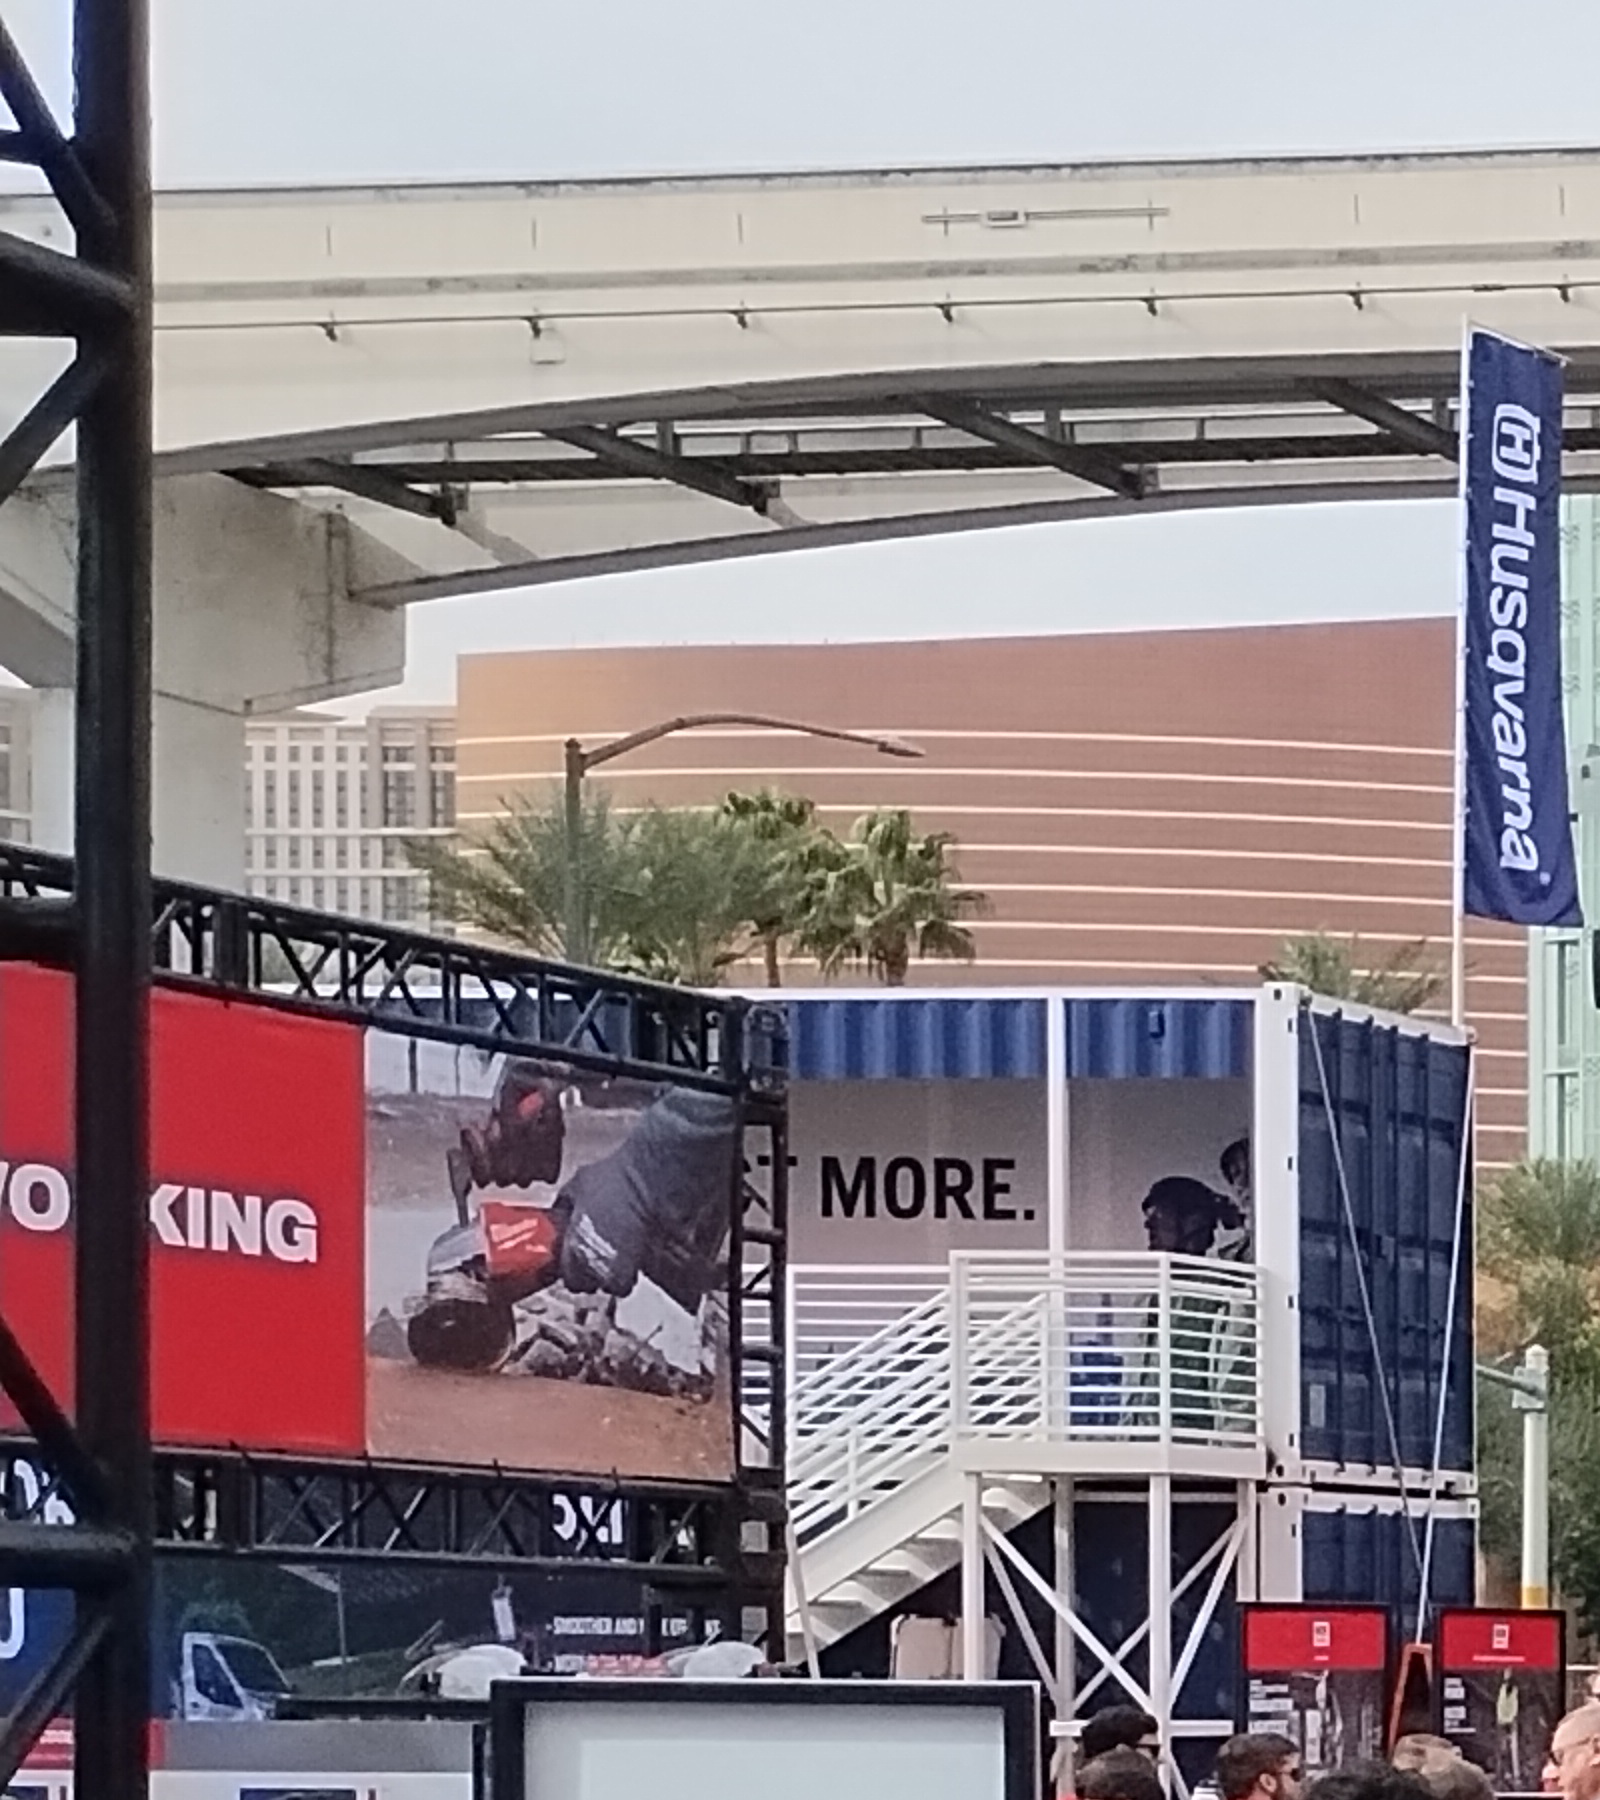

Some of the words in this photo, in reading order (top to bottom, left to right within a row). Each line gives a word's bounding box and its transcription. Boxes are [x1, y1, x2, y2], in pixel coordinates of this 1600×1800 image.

[1487, 485, 1539, 871] Husqvarna
[0, 1162, 318, 1262] OKING
[819, 1156, 1035, 1221] MORE.
